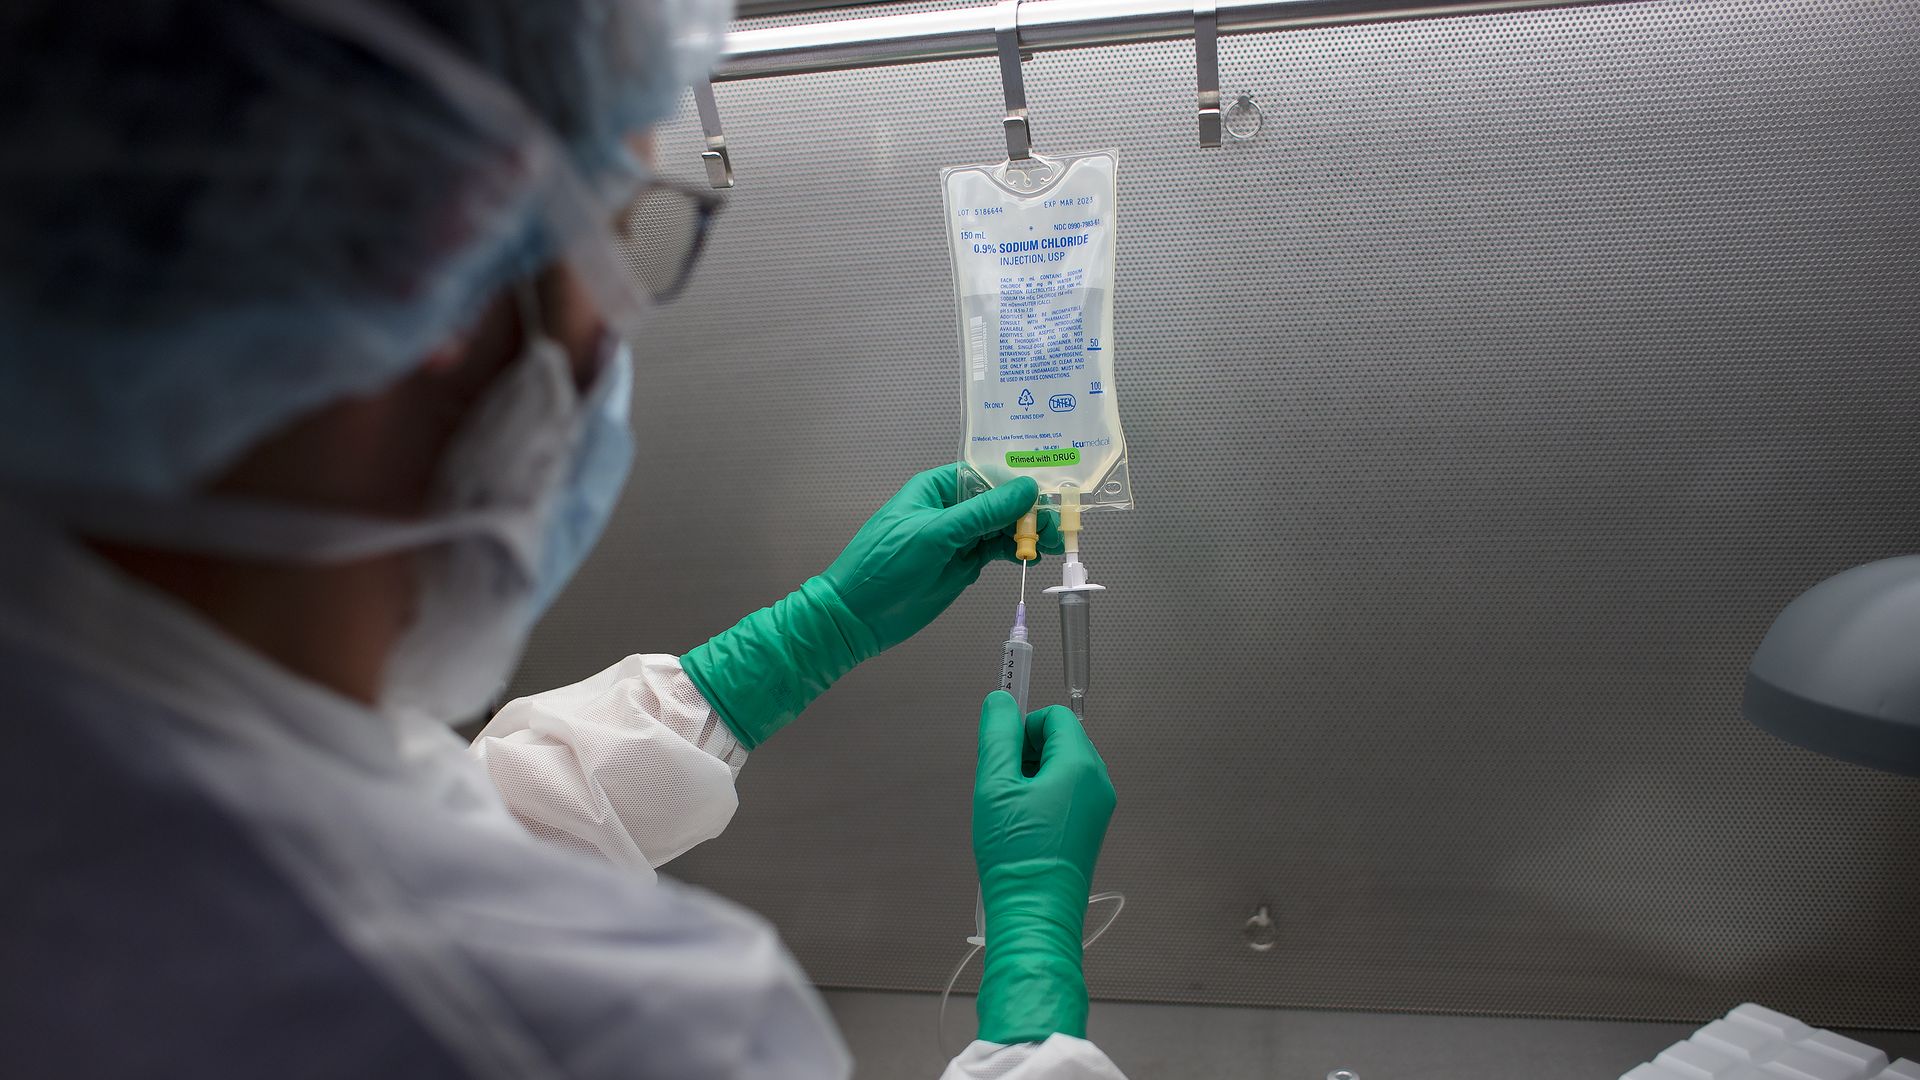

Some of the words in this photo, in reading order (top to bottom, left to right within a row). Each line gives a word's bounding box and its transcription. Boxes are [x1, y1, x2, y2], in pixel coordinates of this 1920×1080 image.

[974, 244, 996, 253] 0.9%
[1000, 240, 1038, 253] SODIUM
[1042, 234, 1088, 249] CHLORIDE
[1000, 253, 1045, 266] INJECTION,
[1048, 252, 1065, 261] USP
[1090, 382, 1101, 390] 100
[1052, 398, 1072, 409] LATEX
[1053, 452, 1076, 461] DRUG
